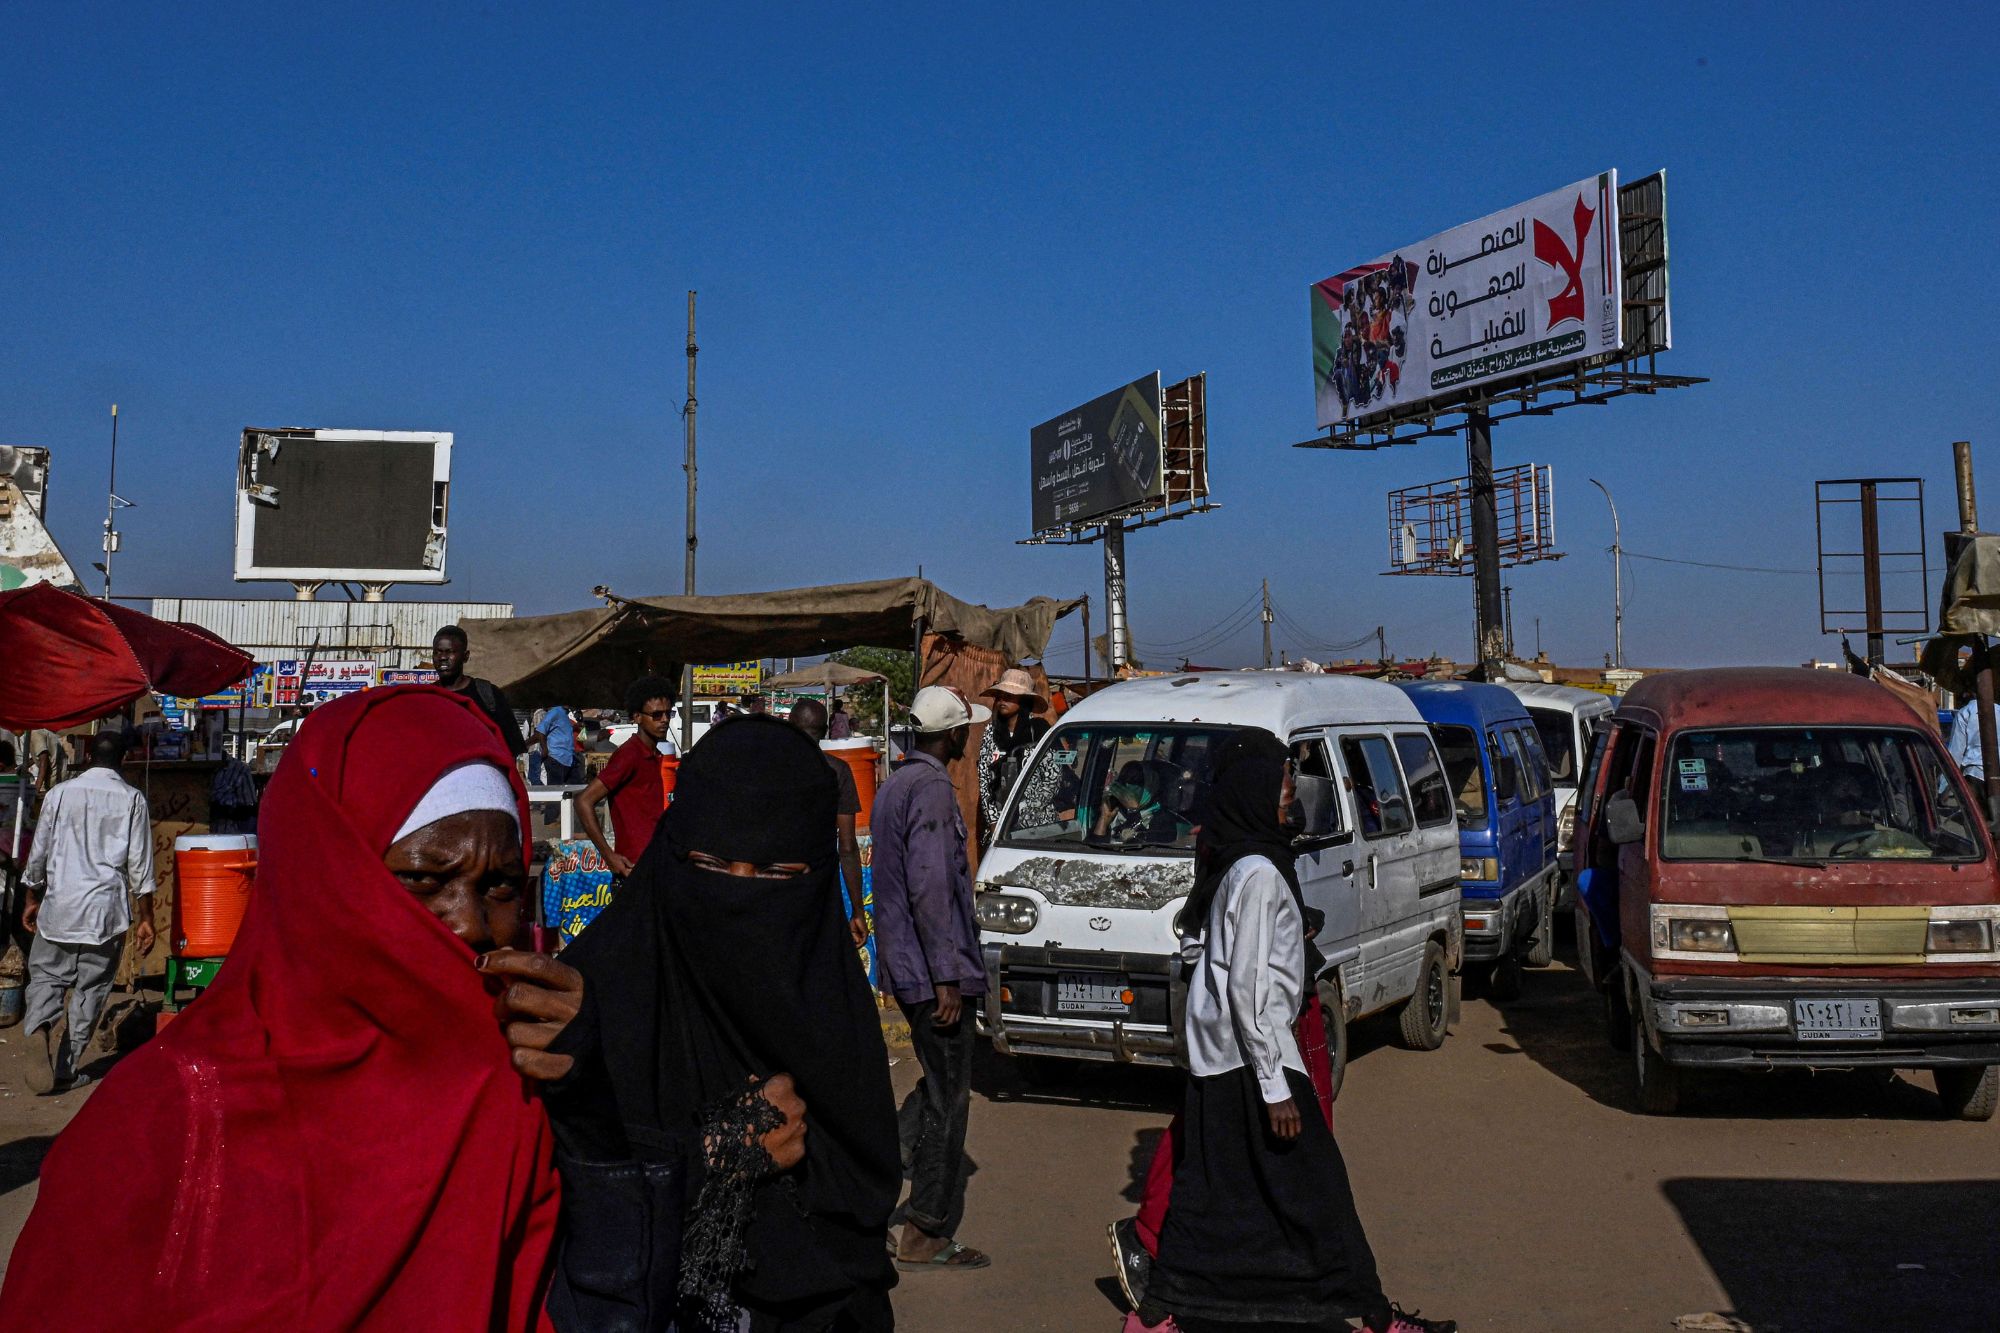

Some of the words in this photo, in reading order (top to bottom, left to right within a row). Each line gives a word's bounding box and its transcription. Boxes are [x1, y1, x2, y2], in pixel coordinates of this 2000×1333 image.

[1427, 217, 1525, 278] للعنصرية
[1533, 191, 1596, 333] لا
[1429, 262, 1525, 321] للجهوية
[1431, 308, 1525, 360] للقبلية
[1060, 1002, 1085, 1010] SUDAN
[1799, 1003, 1843, 1020] ١٢٠٤٣
